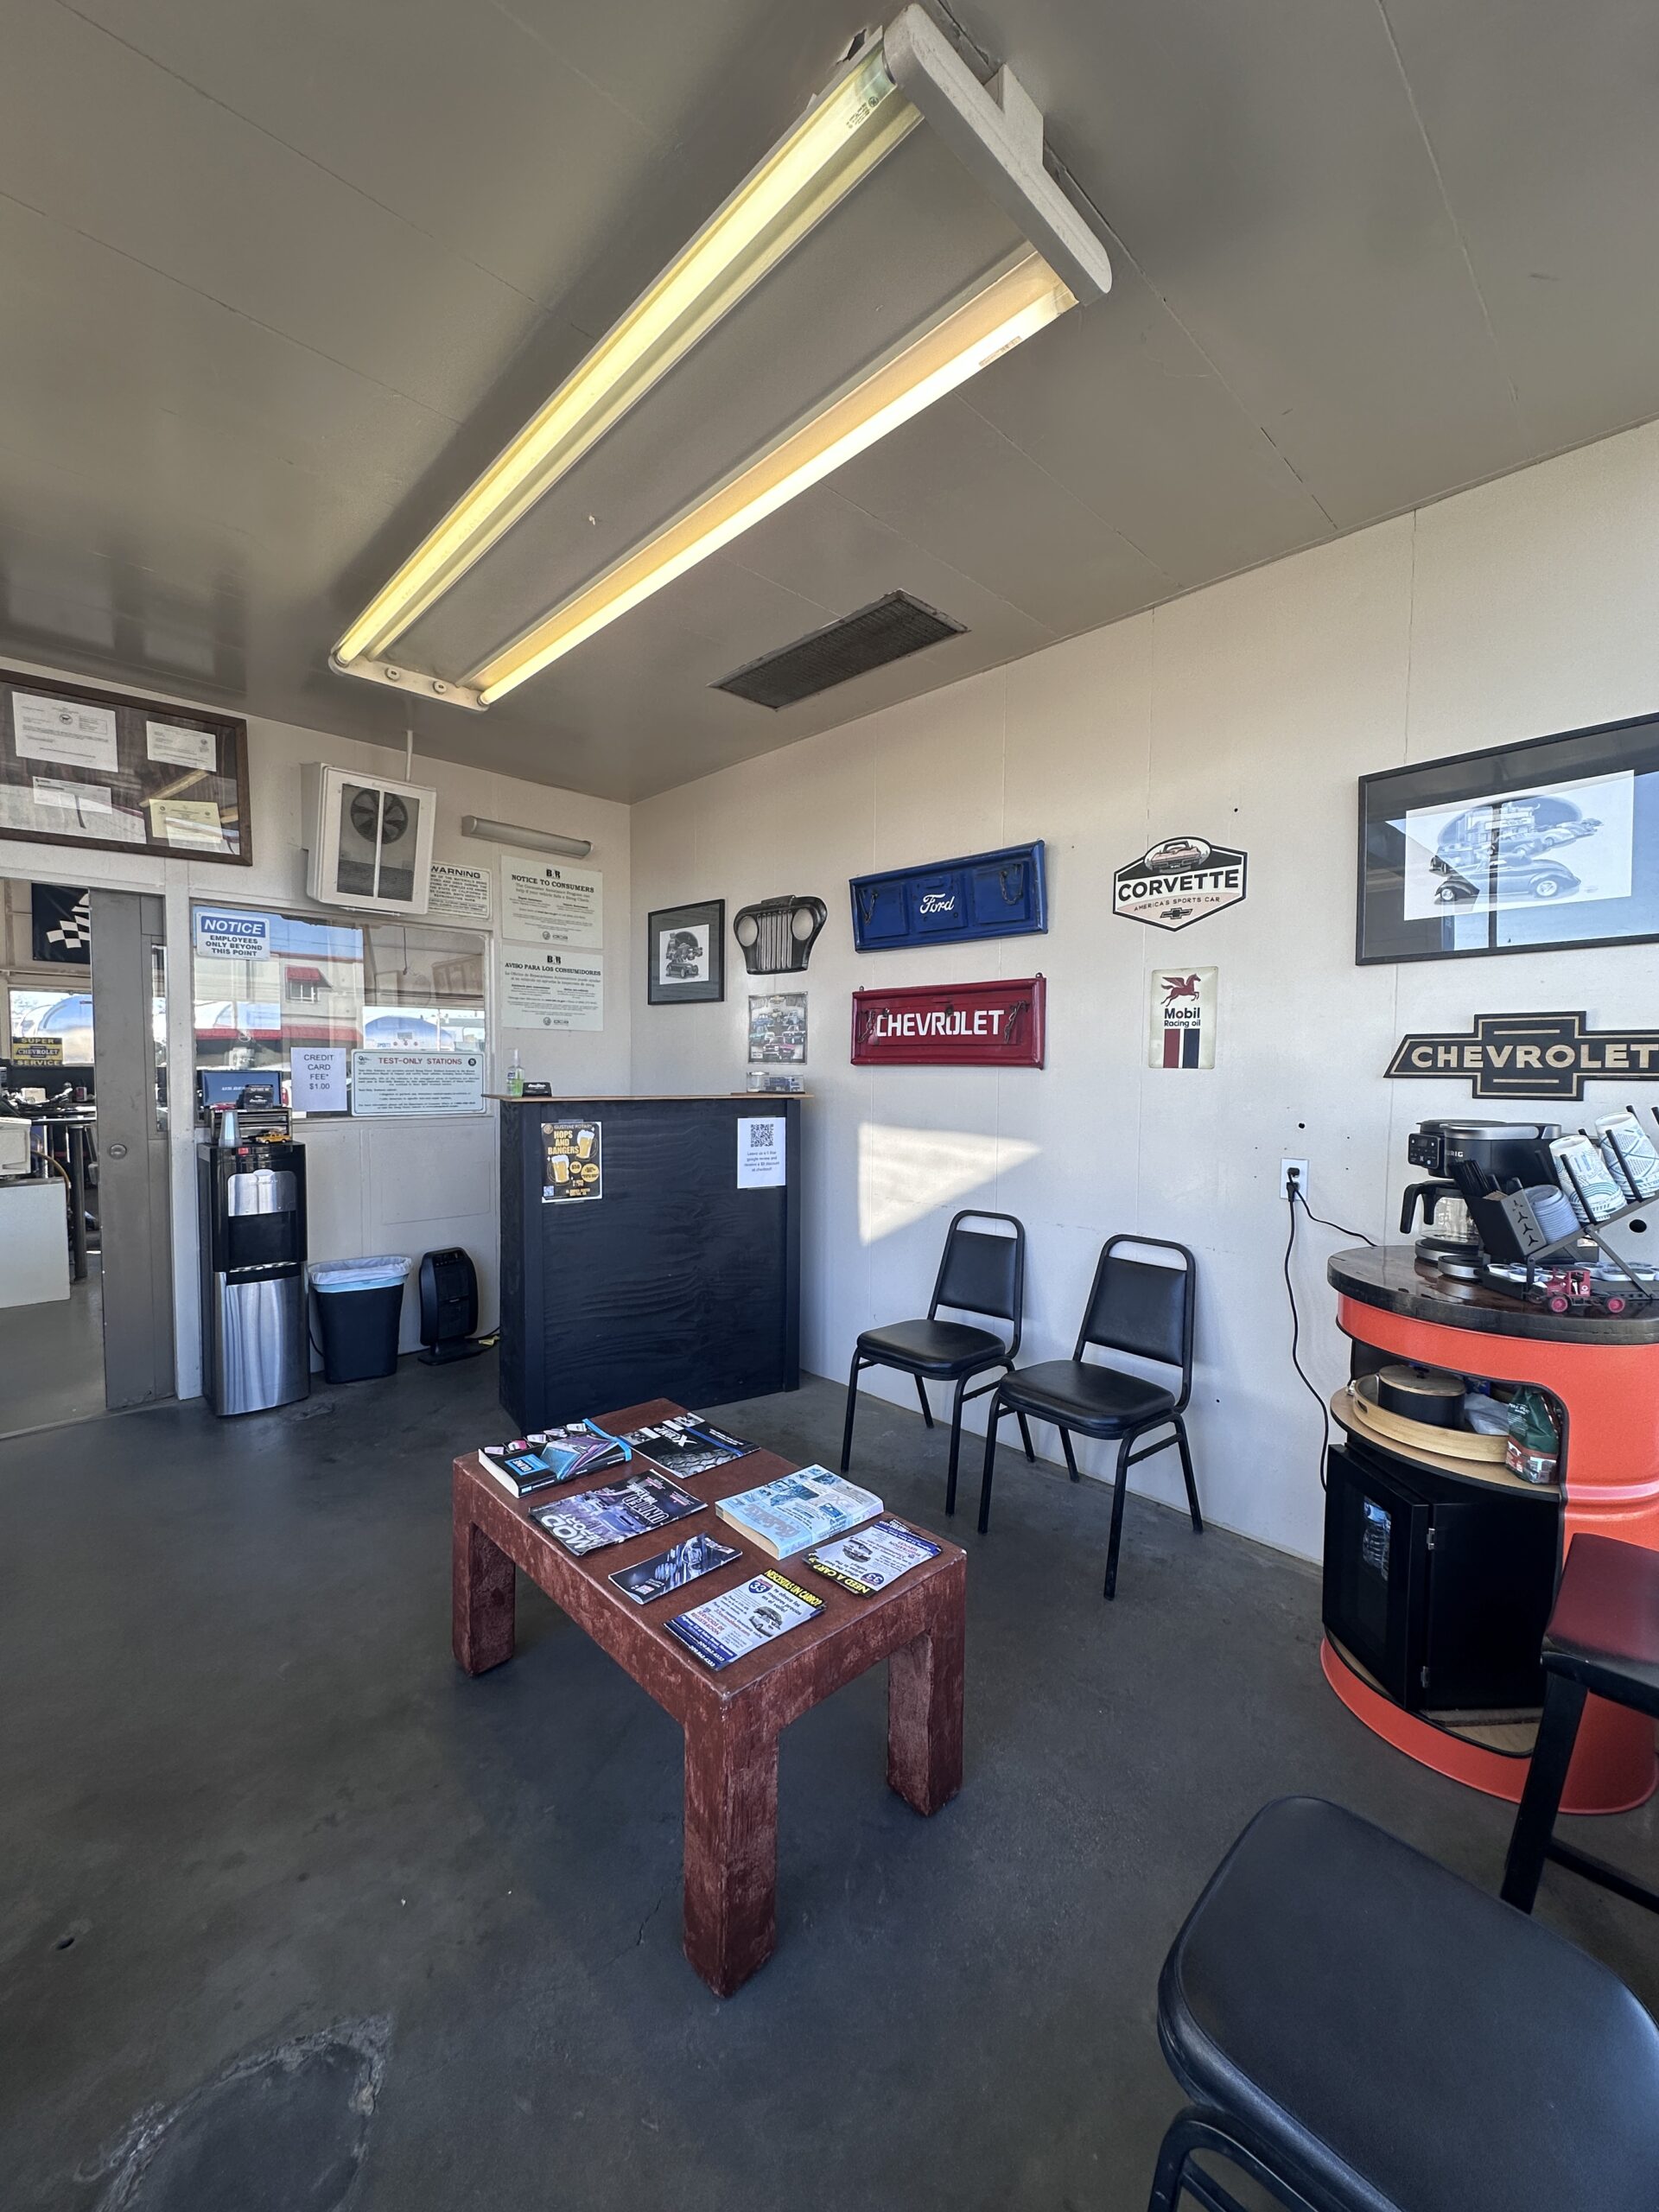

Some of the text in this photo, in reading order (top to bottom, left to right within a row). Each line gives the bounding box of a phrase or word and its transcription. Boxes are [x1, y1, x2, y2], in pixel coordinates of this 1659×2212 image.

[430, 865, 480, 879] WARNING
[512, 874, 537, 885] NOTICE
[551, 880, 594, 893] CONSUMERS
[1118, 869, 1239, 901] CORVETTE
[919, 893, 956, 914] Ford
[1134, 900, 1170, 912] AMERICA'S
[204, 919, 263, 935] NOTICE
[210, 935, 257, 944] EMPLOYEES
[555, 967, 601, 976] CONSUMIDORES
[1164, 1007, 1201, 1019] Mobil
[876, 1009, 1005, 1037] CHEVROLET
[1164, 1020, 1190, 1028] Racing
[378, 1057, 423, 1065] TEST-ONLY
[1410, 1044, 1659, 1069] CHEVROLET
[554, 1130, 573, 1139] HOPS
[555, 1138, 570, 1147] AND
[548, 1146, 580, 1155] BANGERS
[512, 1459, 532, 1471] ULINE
[621, 1494, 670, 1524] UNITED
[541, 1515, 593, 1549] MOD
[813, 1564, 836, 1577] CAR?
[867, 1573, 883, 1584] 33
[750, 1582, 767, 1592] 33
[844, 1578, 871, 1594] NEED
[790, 1585, 802, 1596] UN
[800, 1590, 823, 1606] CARRO?
[696, 1610, 719, 1627] SERVICIOS
